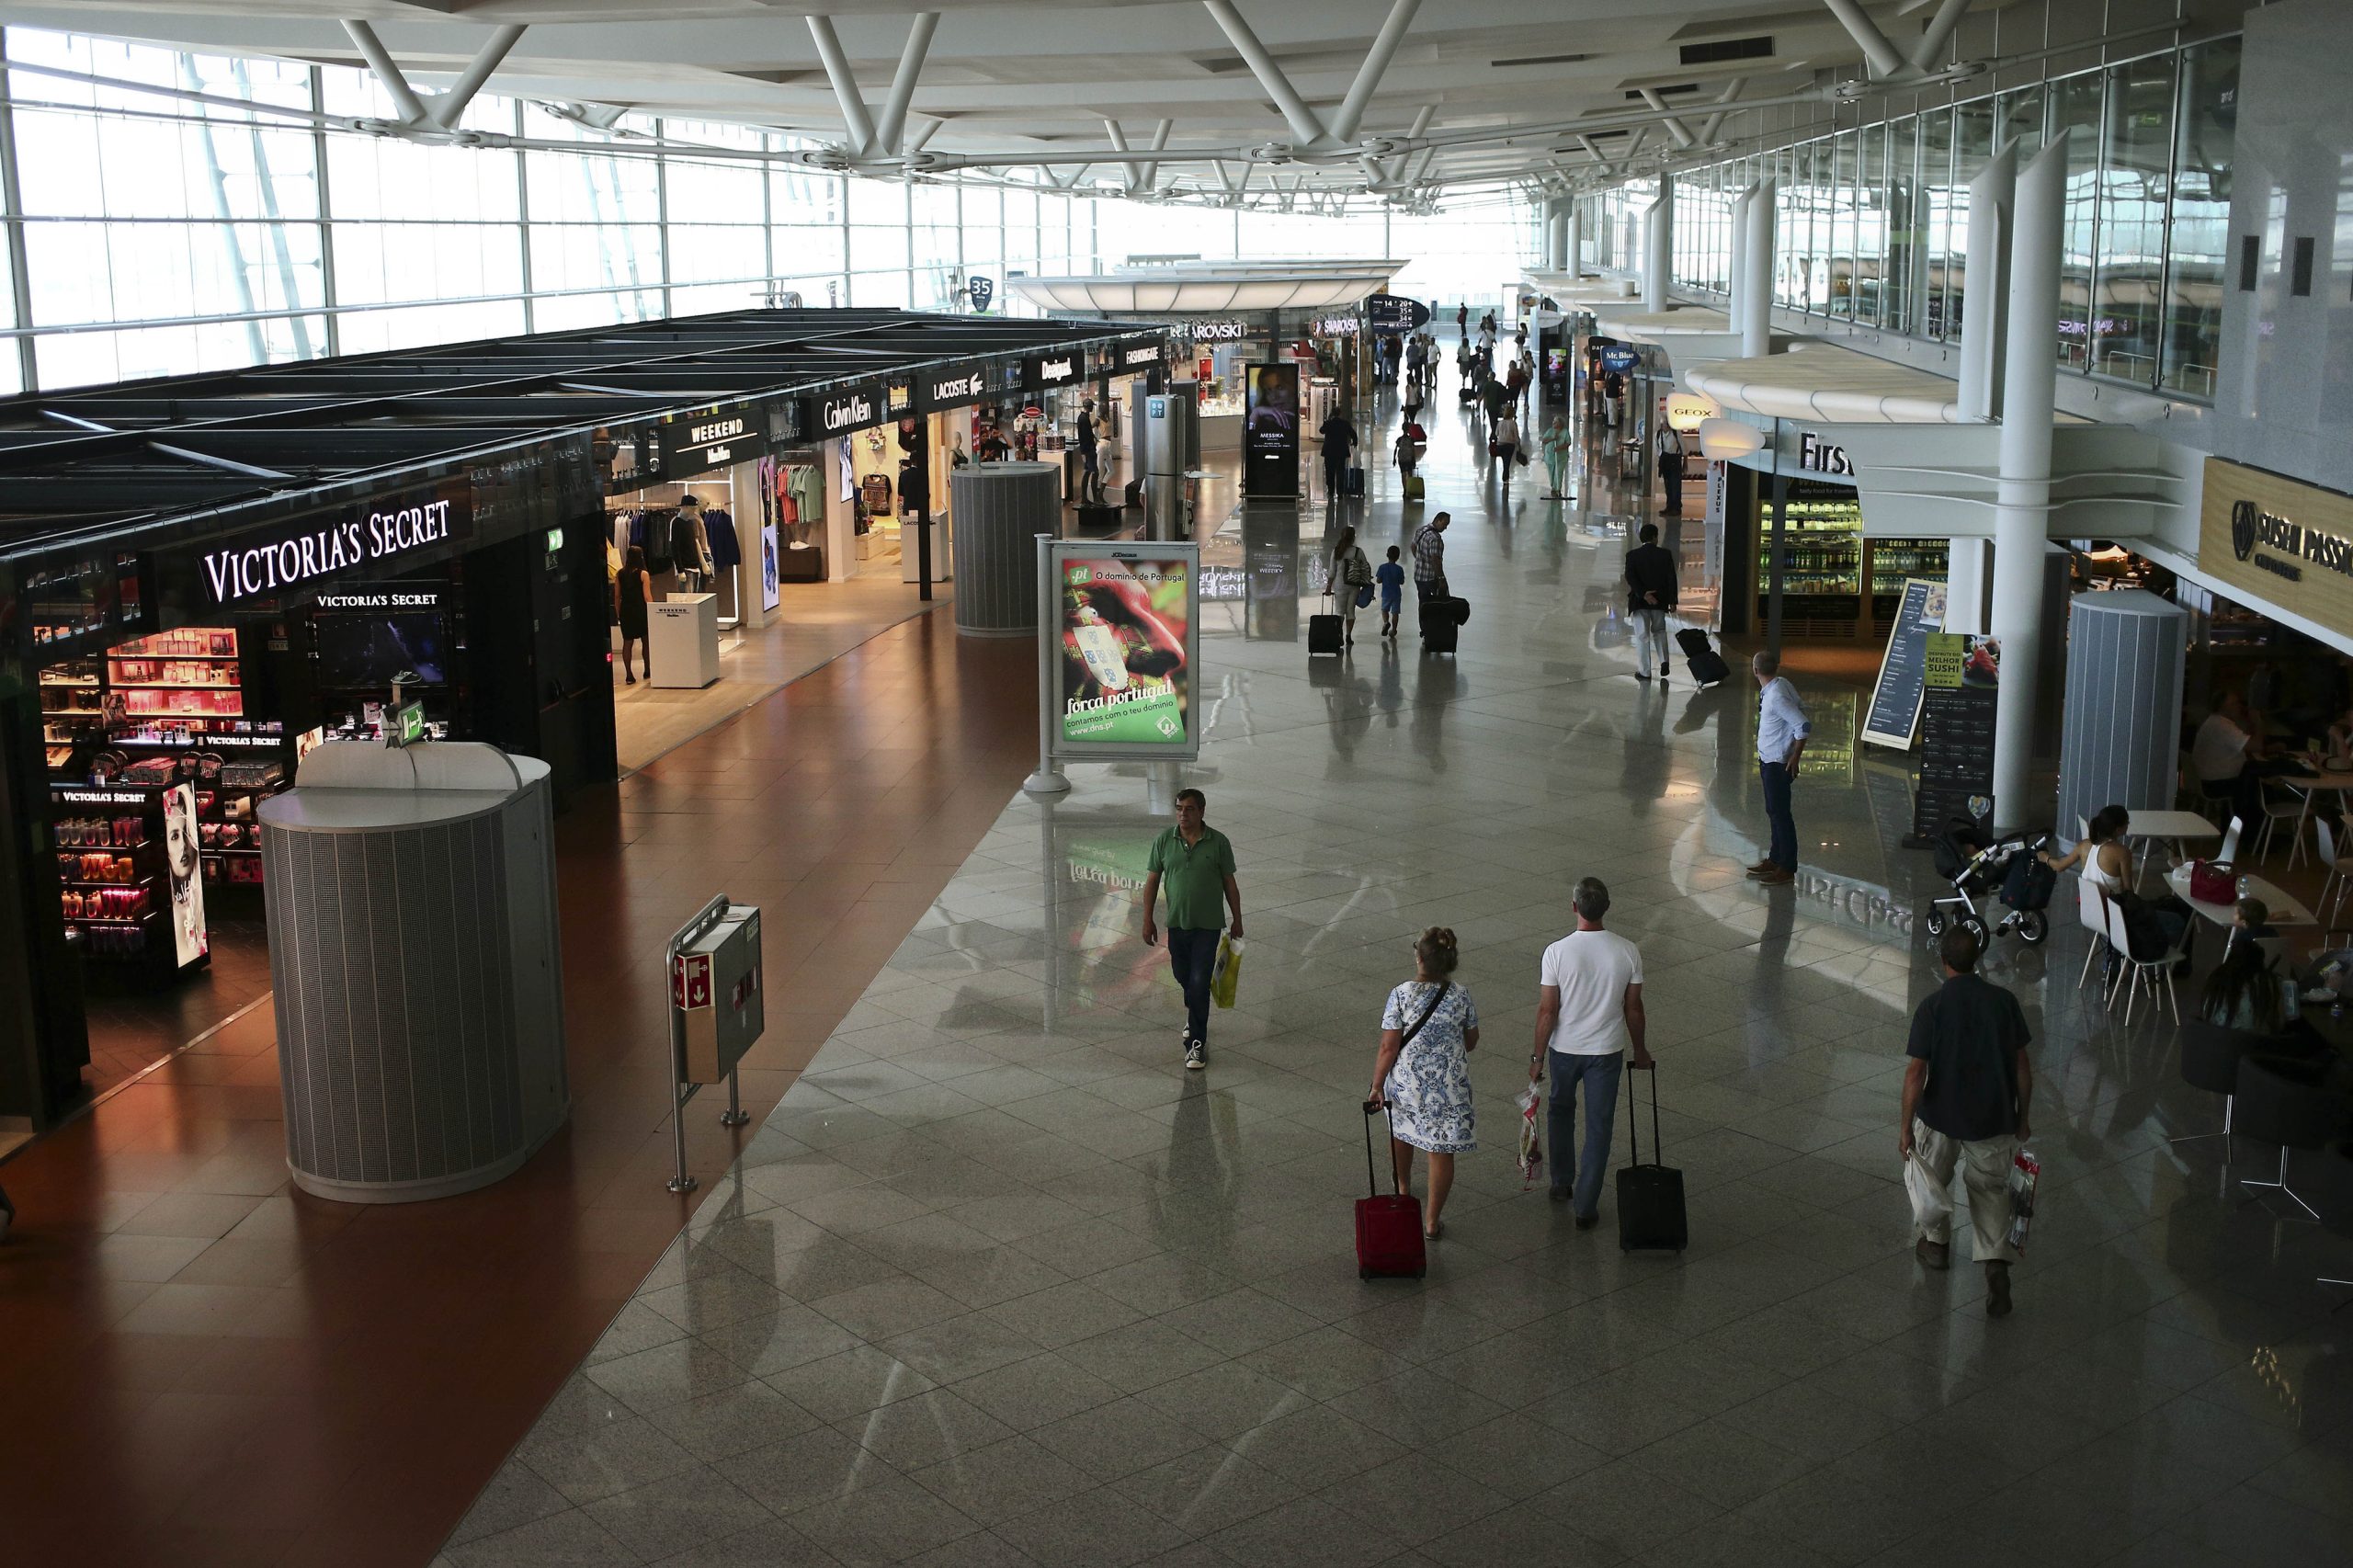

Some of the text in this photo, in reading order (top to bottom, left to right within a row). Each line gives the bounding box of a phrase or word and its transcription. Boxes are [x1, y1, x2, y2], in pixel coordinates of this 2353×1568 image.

[972, 280, 991, 294] 35
[1192, 325, 1242, 339] AROVSKI
[1324, 319, 1358, 334] SWAROVSKI
[1126, 347, 1159, 365] FASHIONGATE
[1619, 351, 1634, 359] Blue
[1041, 358, 1073, 381] Desigual
[933, 379, 969, 401] LACOSTE
[824, 393, 871, 430] Calvin Klein
[1675, 408, 1712, 417] GEOX
[691, 418, 744, 444] WEEKEND
[1800, 431, 1855, 476] Firs
[2256, 513, 2302, 556] SUSHI
[204, 500, 449, 603] VICTORIA'S SECRET
[1139, 572, 1149, 580] de
[1151, 573, 1185, 583] Portugal
[317, 594, 437, 608] VICTORIA'S SECRET
[1927, 664, 1959, 673] SUSHI
[1065, 678, 1171, 720] força portugal
[1066, 715, 1104, 728] contamos
[1105, 711, 1121, 720] com
[1129, 707, 1142, 715] teu
[1069, 722, 1114, 736] www.dns.pt
[252, 737, 281, 745] SECRET
[113, 793, 145, 802] SECRET
